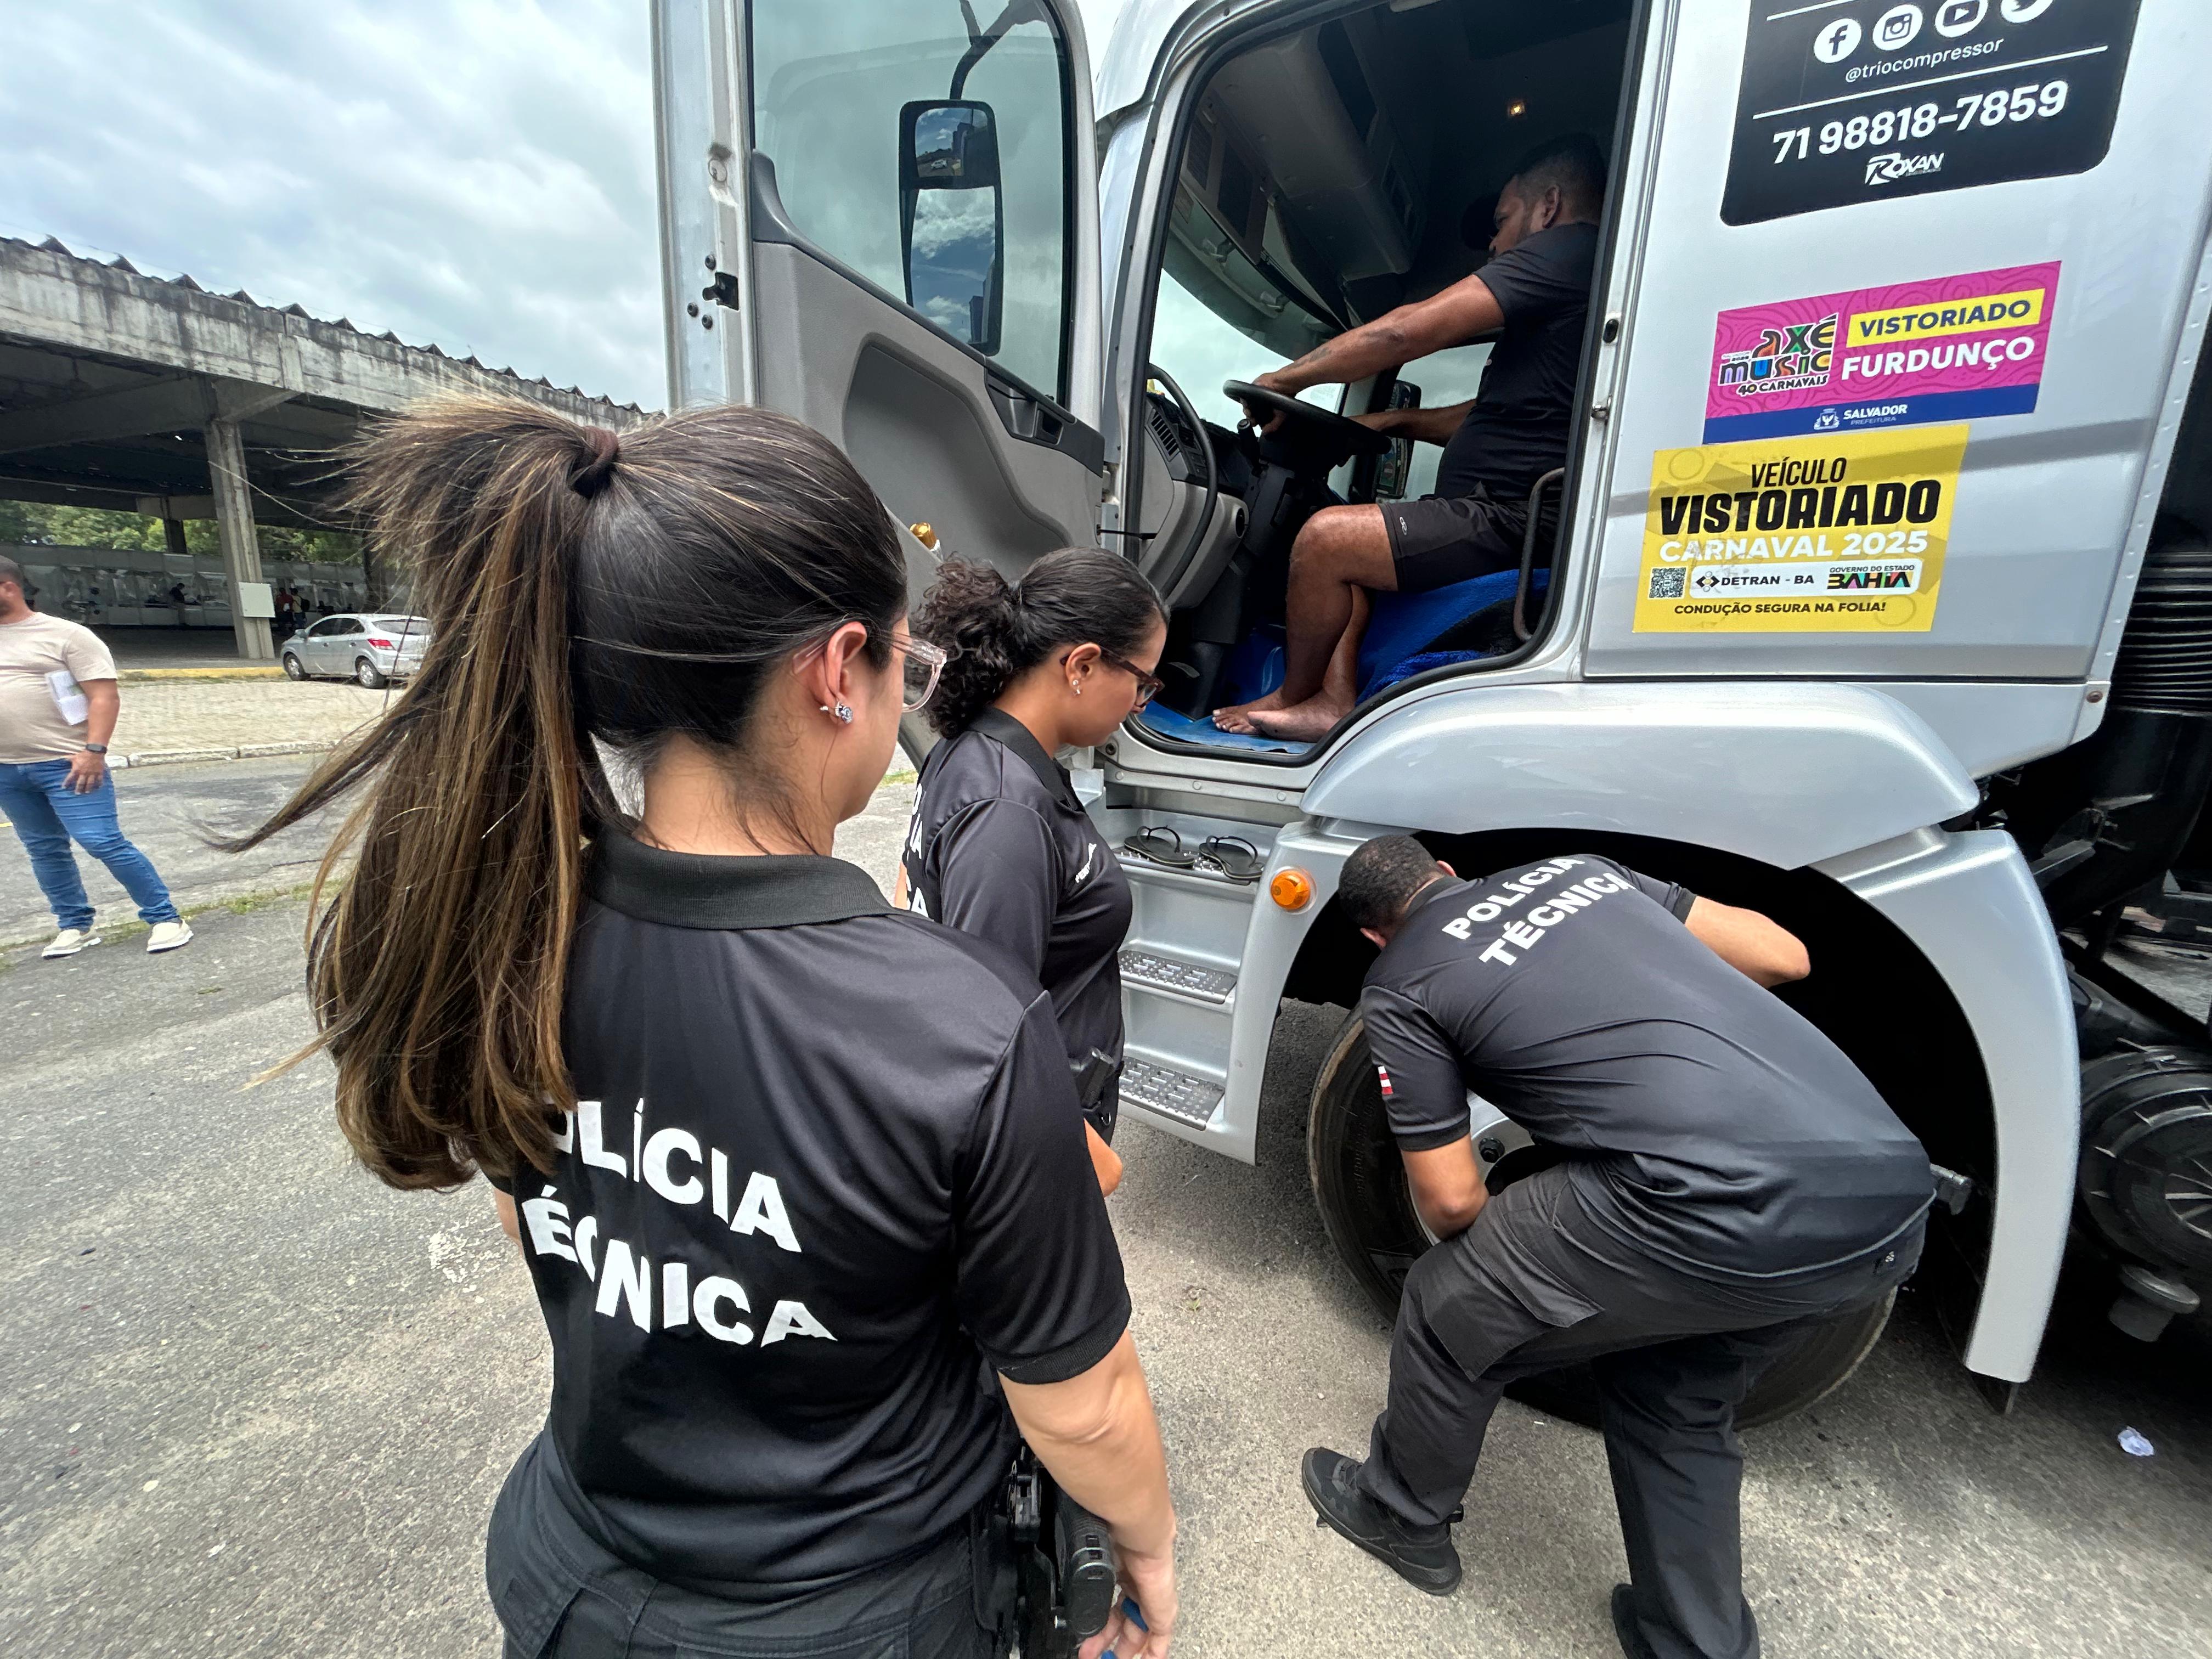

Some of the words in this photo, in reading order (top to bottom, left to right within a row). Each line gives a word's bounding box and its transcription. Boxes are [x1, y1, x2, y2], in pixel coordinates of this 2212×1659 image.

[1845, 38, 2005, 82] @triocompressor
[1773, 126, 1810, 164] 71
[1818, 80, 2068, 155] 98818-7859
[1860, 300, 2032, 338] VISTORIADO
[1841, 336, 2035, 381] FURDUNÇO
[1738, 384, 1757, 395] 40
[1759, 375, 1828, 392] CARNAVAIS
[1843, 404, 1908, 420] SALVADOR
[1850, 416, 1897, 425] PREFEITURA
[1751, 456, 1847, 488] VEÍCULO
[1660, 479, 1942, 535] VISTORIADO
[1660, 534, 1833, 562] CARNAVAL
[1841, 531, 1928, 556] 2025
[1721, 575, 1781, 586] DETRAN
[1794, 575, 1815, 584] BA
[1674, 602, 1752, 616] CONDUÇÃO
[1754, 603, 1811, 613] SEGURA
[1814, 603, 1835, 613] NA
[1838, 602, 1886, 612] FOLIA!
[1442, 856, 1585, 940] POLÍCIA
[1479, 872, 1638, 966] TÉCNICA
[522, 1184, 838, 1347] ÉCNICA
